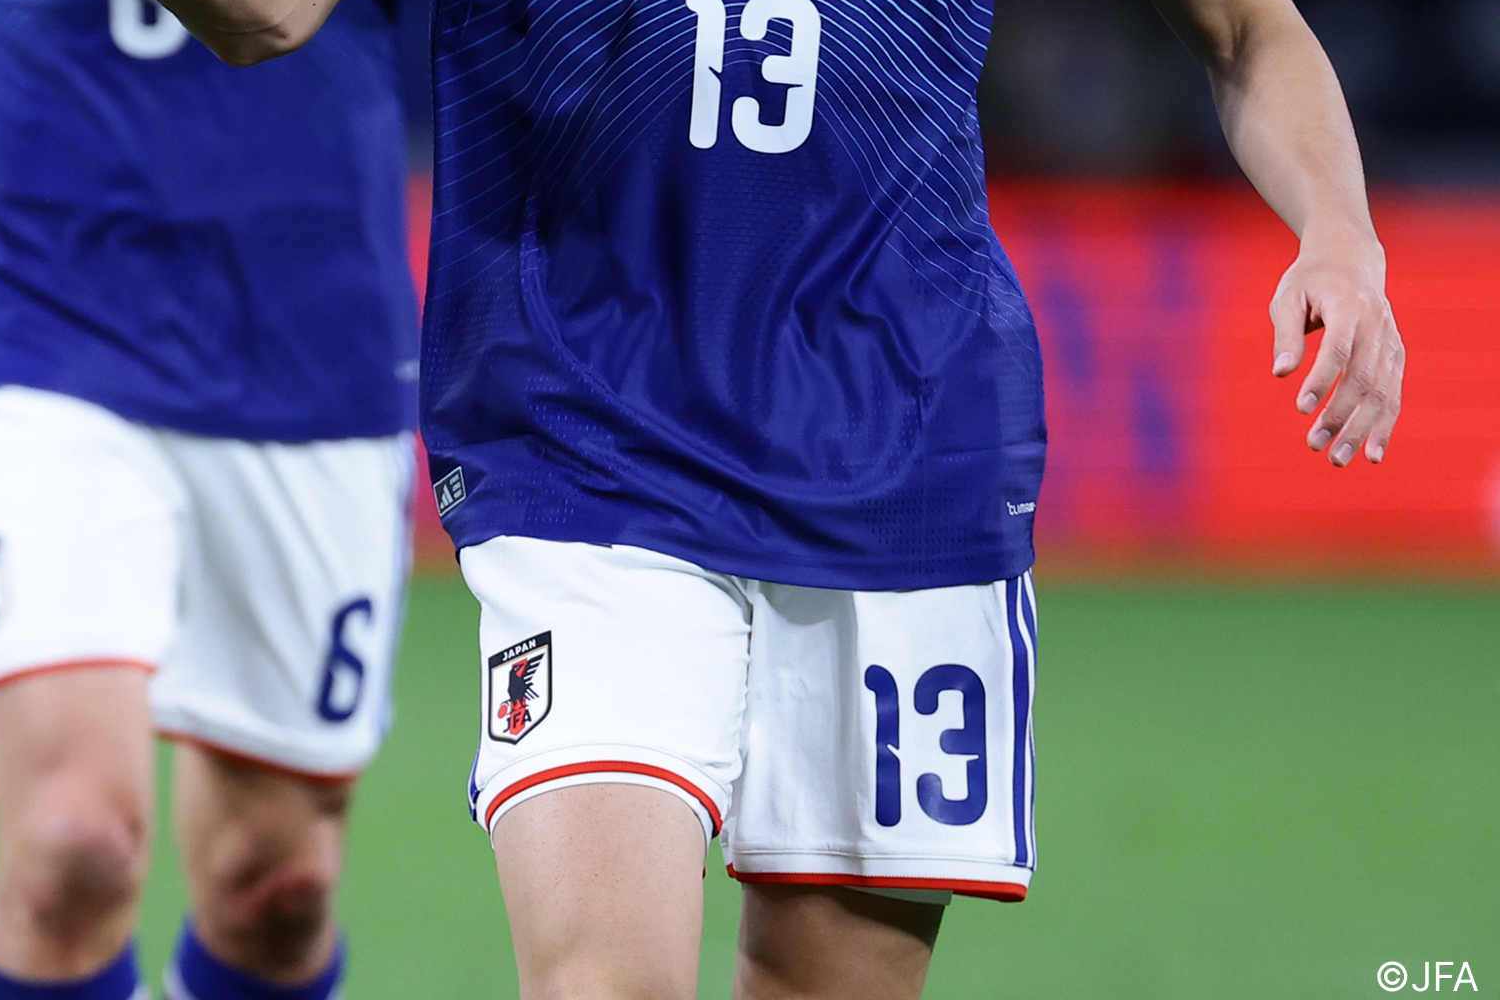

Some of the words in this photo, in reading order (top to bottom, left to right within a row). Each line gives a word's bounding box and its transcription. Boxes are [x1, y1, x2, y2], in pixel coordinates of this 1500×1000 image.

[314, 595, 373, 725] 6
[502, 639, 537, 662] JAPAN
[503, 708, 532, 733] JFA
[863, 663, 988, 828] 13
